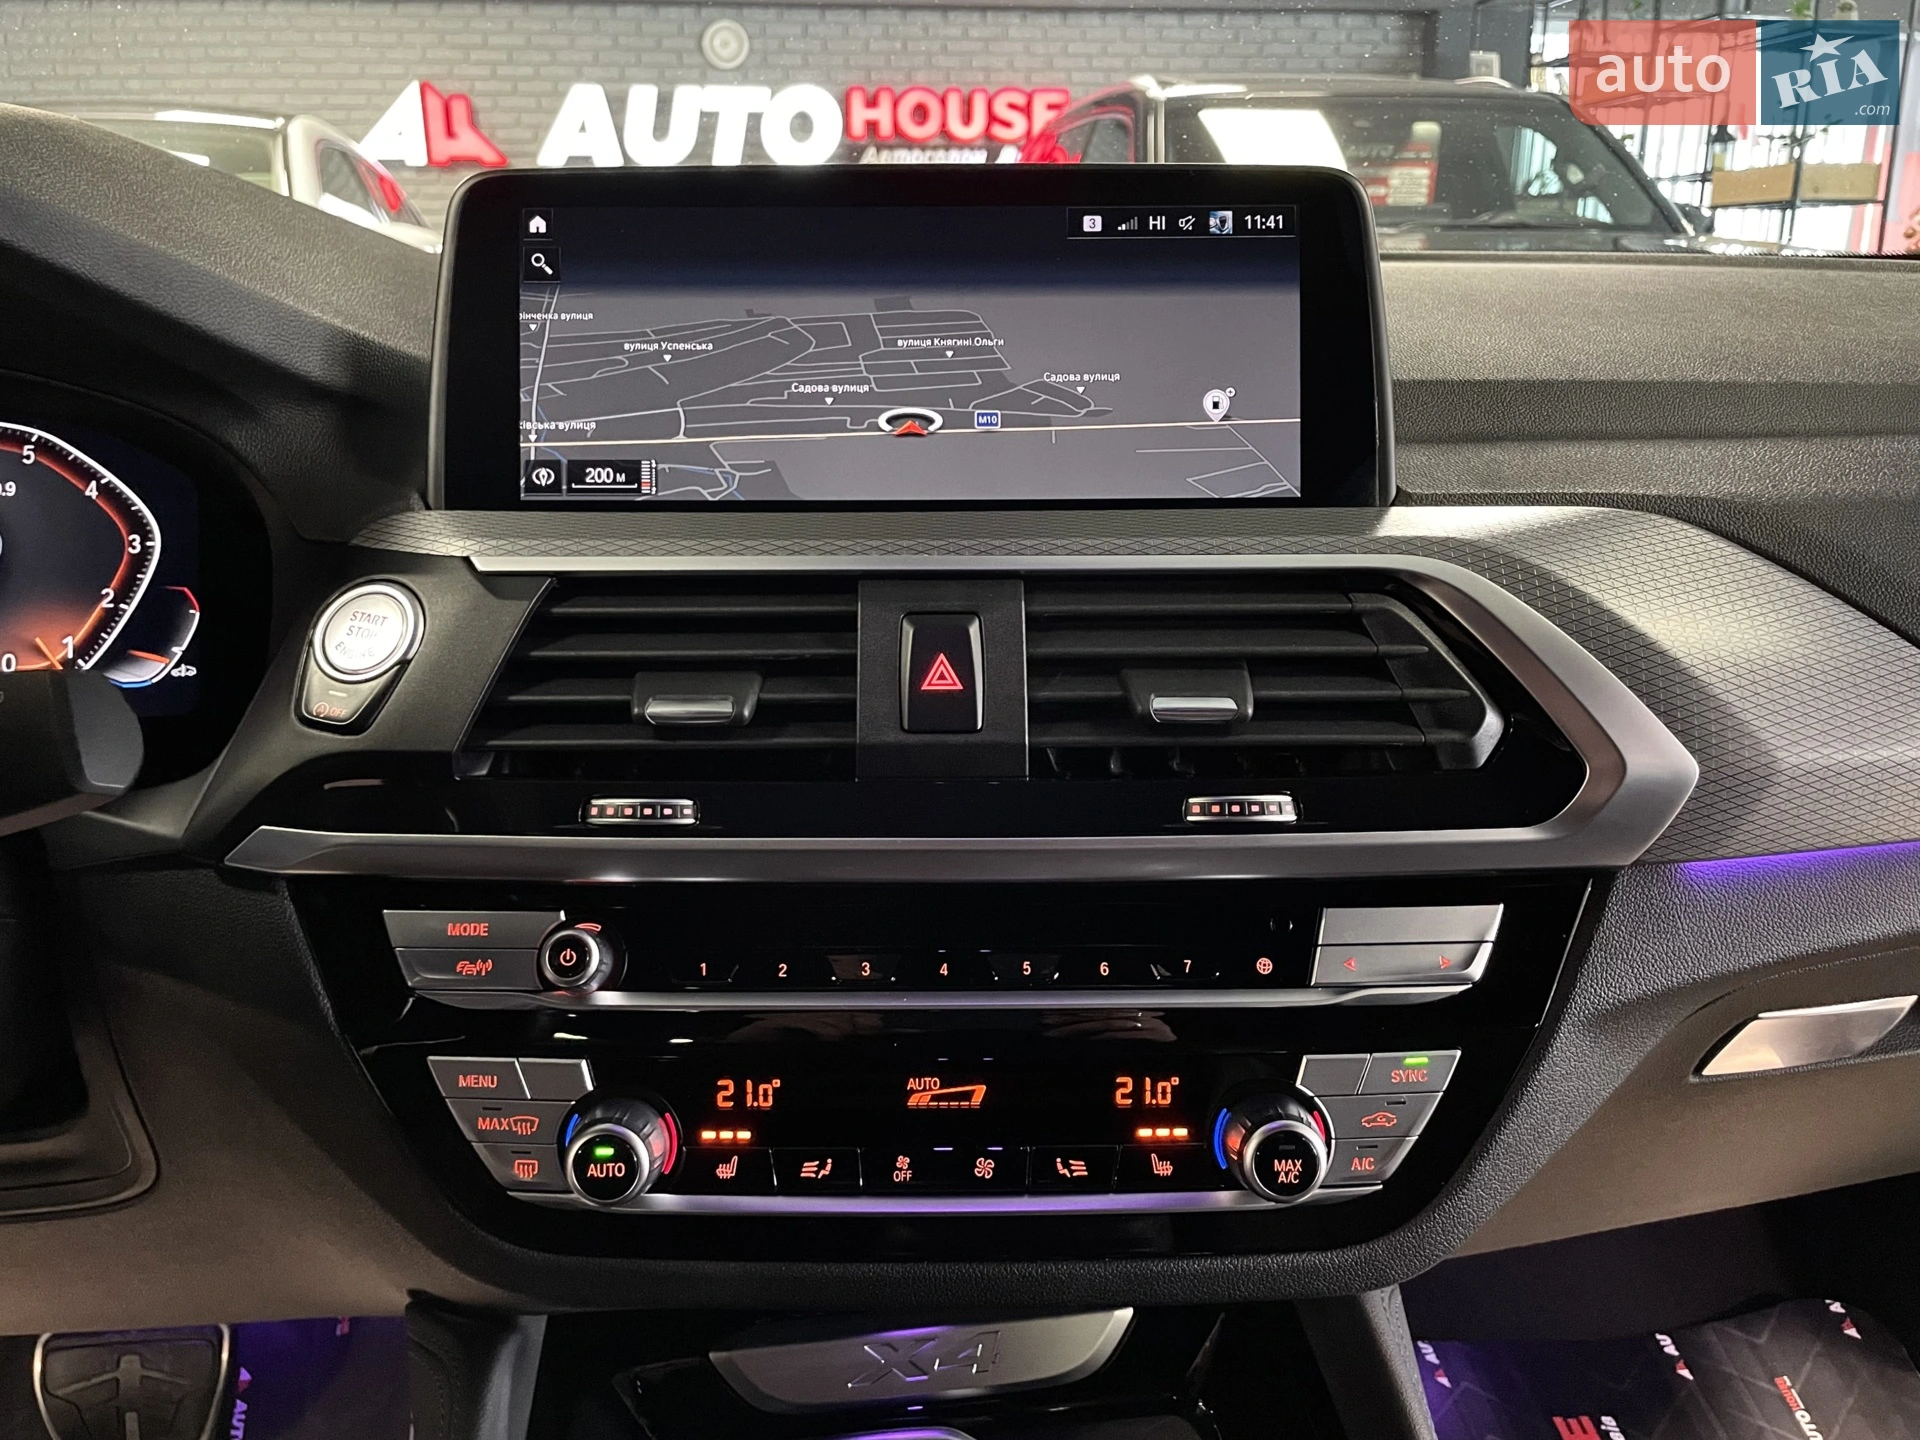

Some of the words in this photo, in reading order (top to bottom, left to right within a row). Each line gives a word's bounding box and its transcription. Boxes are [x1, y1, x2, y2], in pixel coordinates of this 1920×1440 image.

[537, 82, 844, 167] AUTO
[1088, 218, 1097, 229] 3
[1149, 215, 1166, 231] HI
[1244, 214, 1284, 230] 11:41
[560, 312, 594, 322] вулиця
[623, 342, 659, 352] вулиця
[660, 341, 713, 351] Успенська
[897, 339, 932, 350] вулиця
[933, 337, 972, 348] Княгині
[974, 336, 1004, 348] Ольги
[1043, 372, 1082, 384] Садова
[1083, 373, 1120, 385] вулиця
[791, 382, 827, 395] Садова
[829, 383, 870, 395] вулиця
[558, 421, 597, 432] вулиця
[978, 414, 998, 425] M10
[22, 445, 36, 465] 5
[585, 467, 614, 484] 200
[0, 481, 17, 497] .9
[85, 481, 98, 499] 4
[127, 534, 142, 554] 3
[101, 588, 115, 608] 2
[350, 610, 388, 627] START
[62, 635, 74, 659] 1
[2, 653, 17, 673] 0
[329, 707, 348, 717] OFF
[447, 922, 489, 938] MODE
[699, 962, 707, 976] 1
[778, 963, 788, 978] 2
[861, 962, 871, 976] 3
[939, 962, 949, 976] 4
[1022, 962, 1032, 976] 5
[1100, 961, 1109, 976] 6
[1183, 960, 1192, 974] 7
[458, 1074, 499, 1088] MENU
[1391, 1069, 1429, 1083] SYNC
[907, 1077, 941, 1091] AUTO
[477, 1116, 510, 1131] MAX
[587, 1162, 626, 1178] AUTO
[1273, 1158, 1303, 1172] MAX
[1351, 1157, 1375, 1171] A/C
[893, 1169, 913, 1182] OFF
[1277, 1171, 1300, 1184] A/C
[847, 1331, 1001, 1388] X4
[229, 1399, 249, 1440] AUT
